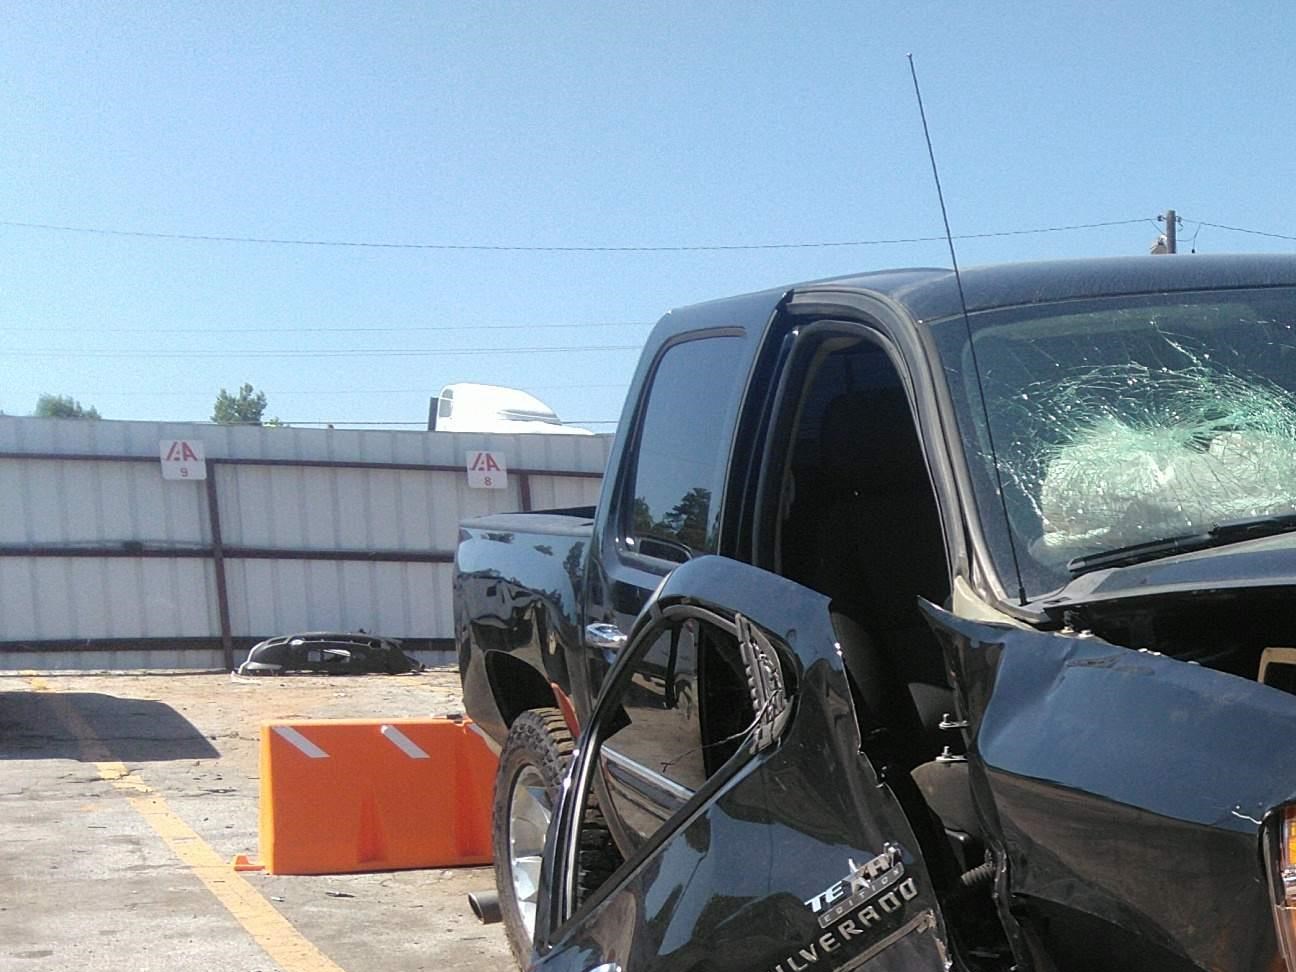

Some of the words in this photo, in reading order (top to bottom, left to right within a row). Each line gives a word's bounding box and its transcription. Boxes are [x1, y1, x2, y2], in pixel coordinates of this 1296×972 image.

[179, 467, 189, 478] 9
[484, 476, 492, 487] 8
[822, 867, 900, 922] EDITION
